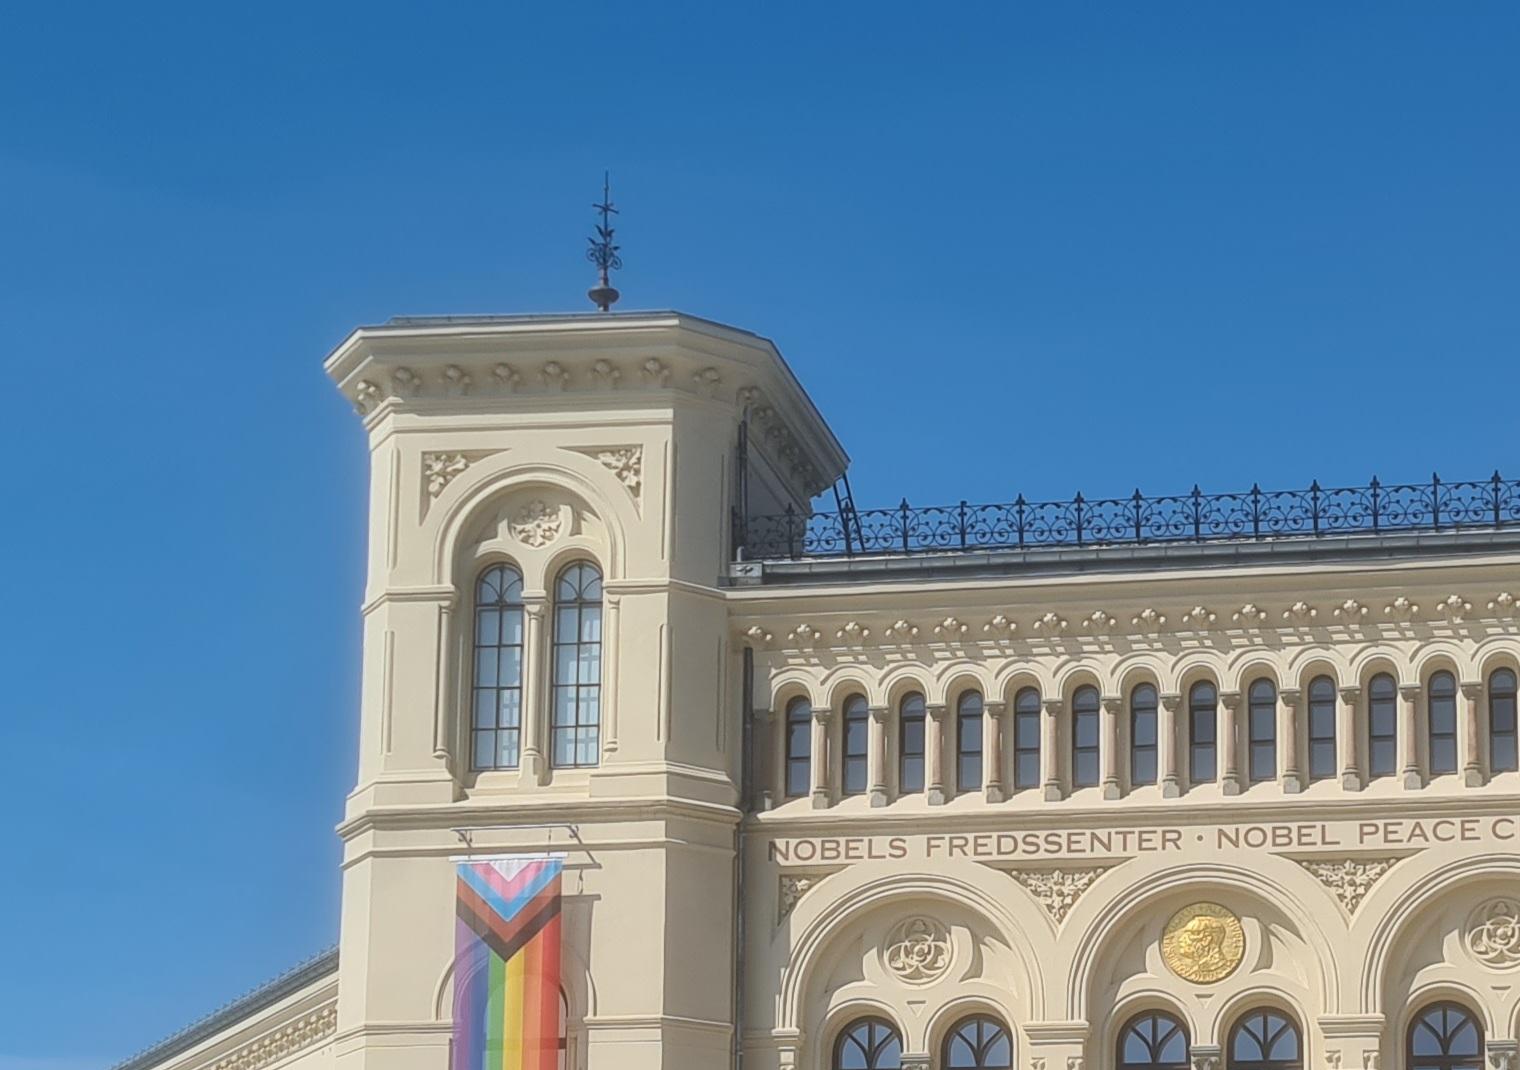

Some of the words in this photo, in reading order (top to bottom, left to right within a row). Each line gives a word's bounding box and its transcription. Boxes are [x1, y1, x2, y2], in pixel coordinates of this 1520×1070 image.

[768, 837, 908, 863] NOBELS
[926, 828, 1183, 858] FREDSSENTER
[1217, 823, 1341, 850] NOBEL
[1358, 818, 1482, 845] PEACE
